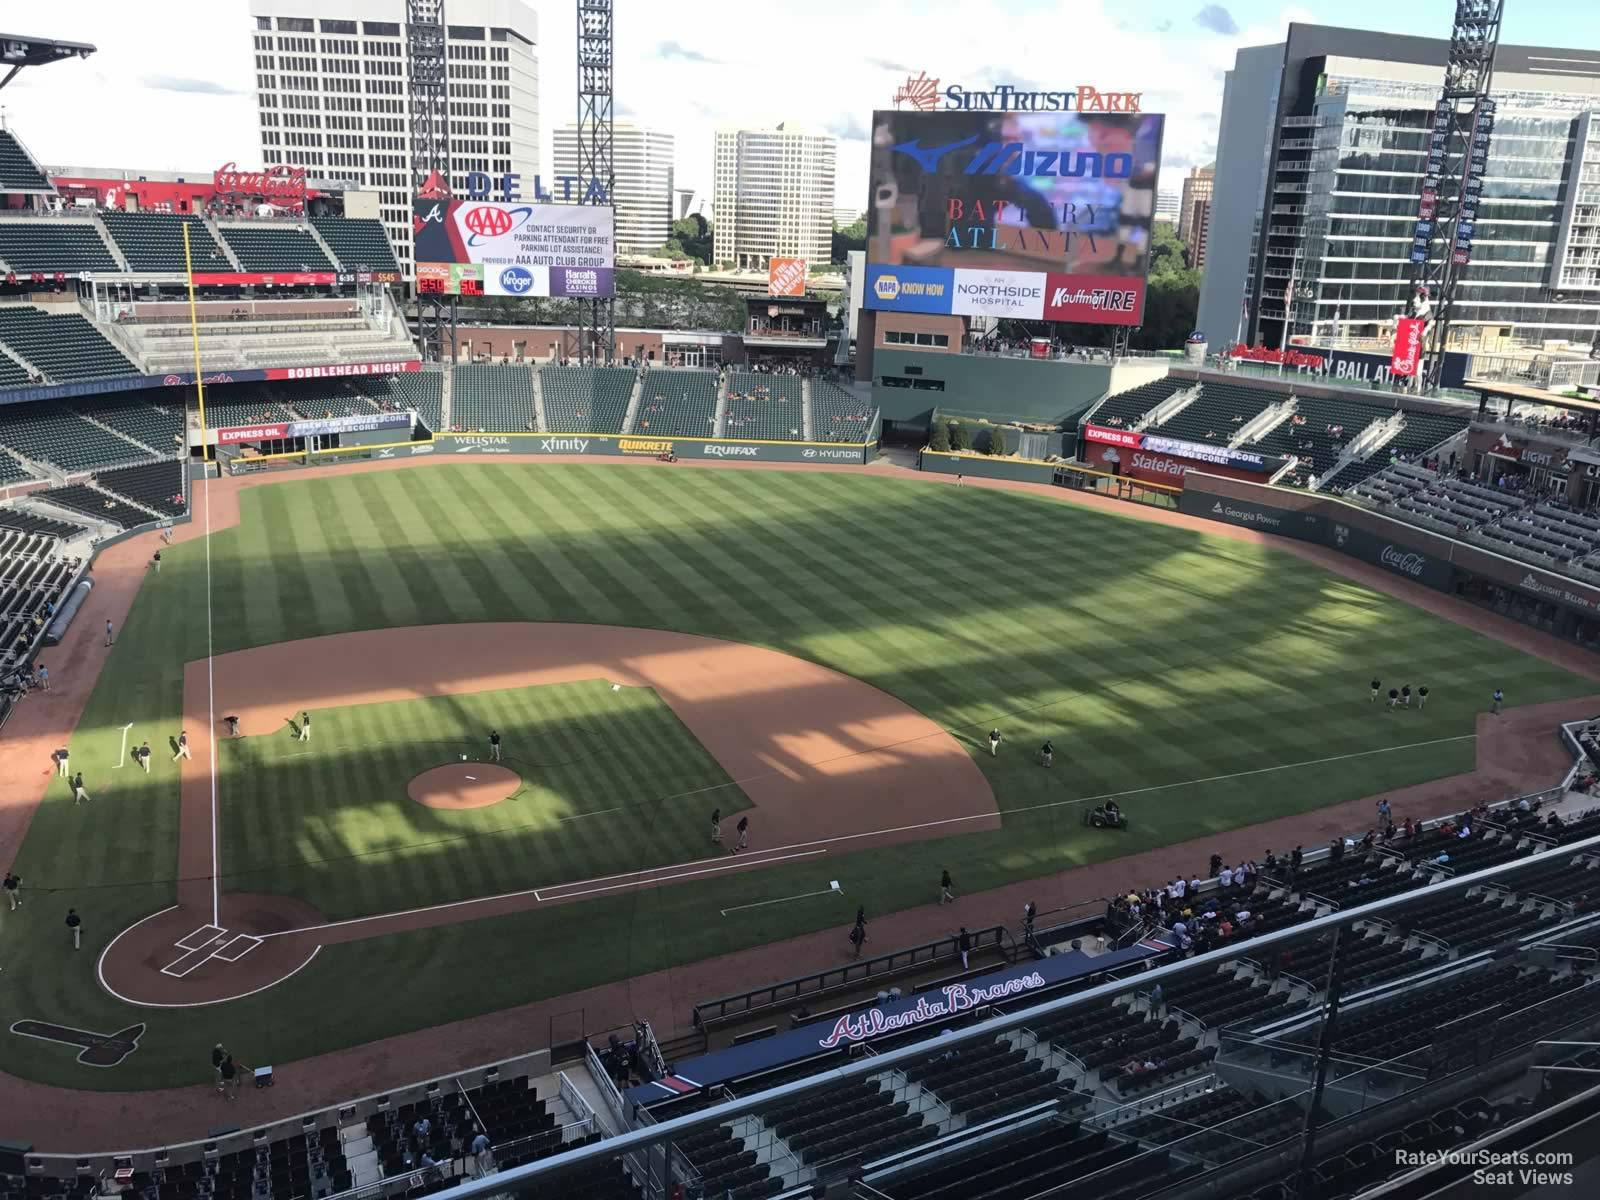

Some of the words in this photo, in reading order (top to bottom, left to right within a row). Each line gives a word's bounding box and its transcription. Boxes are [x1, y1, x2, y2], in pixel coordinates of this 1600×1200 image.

[468, 171, 607, 200] DELTA
[949, 198, 1099, 225] BATTRY
[526, 224, 555, 232] CONTACT
[556, 226, 586, 234] SECURITY
[588, 226, 596, 234] OR
[514, 234, 541, 242] PARKING
[543, 235, 579, 244] ATTENDANT
[594, 237, 608, 245] FREE
[944, 226, 1097, 253] ATLANTA
[521, 244, 548, 252] PARKING
[563, 246, 602, 254] ASSISTANCE!
[515, 256, 532, 264] AAA
[533, 256, 553, 265] AUTO
[555, 257, 576, 266] CLUB
[577, 258, 604, 266] GROUP
[79, 271, 92, 282] 42
[340, 274, 354, 282] 6:35
[504, 270, 531, 291] Kroger
[769, 260, 805, 294] HOME
[878, 282, 896, 293] NAPA
[902, 282, 924, 295] KNOW
[926, 284, 944, 296] HOW
[957, 284, 1040, 298] NORTHSIDE
[971, 297, 1024, 306] HOSPITAL
[1091, 289, 1136, 312] TIRE
[288, 364, 368, 379] BOBBLEHEAD
[371, 362, 408, 374] NIGHT
[1336, 360, 1370, 382] BALL
[222, 430, 262, 440] EXPRESS
[264, 428, 280, 438] OIL
[348, 424, 379, 432] SCORE!
[1088, 429, 1121, 442] EXPRESS
[1122, 435, 1135, 445] OIL
[541, 436, 589, 453] xfinity
[618, 440, 672, 450] QUIKRETE
[704, 444, 758, 456] EQUIFAX
[819, 450, 861, 459] HYUNDAI
[1197, 452, 1228, 464] SCORE!
[1521, 449, 1552, 466] LIGHT
[1225, 506, 1254, 521] Georgia
[1256, 509, 1280, 526] Power
[819, 998, 946, 1048] Atlanta
[943, 971, 1046, 1014] Braves
